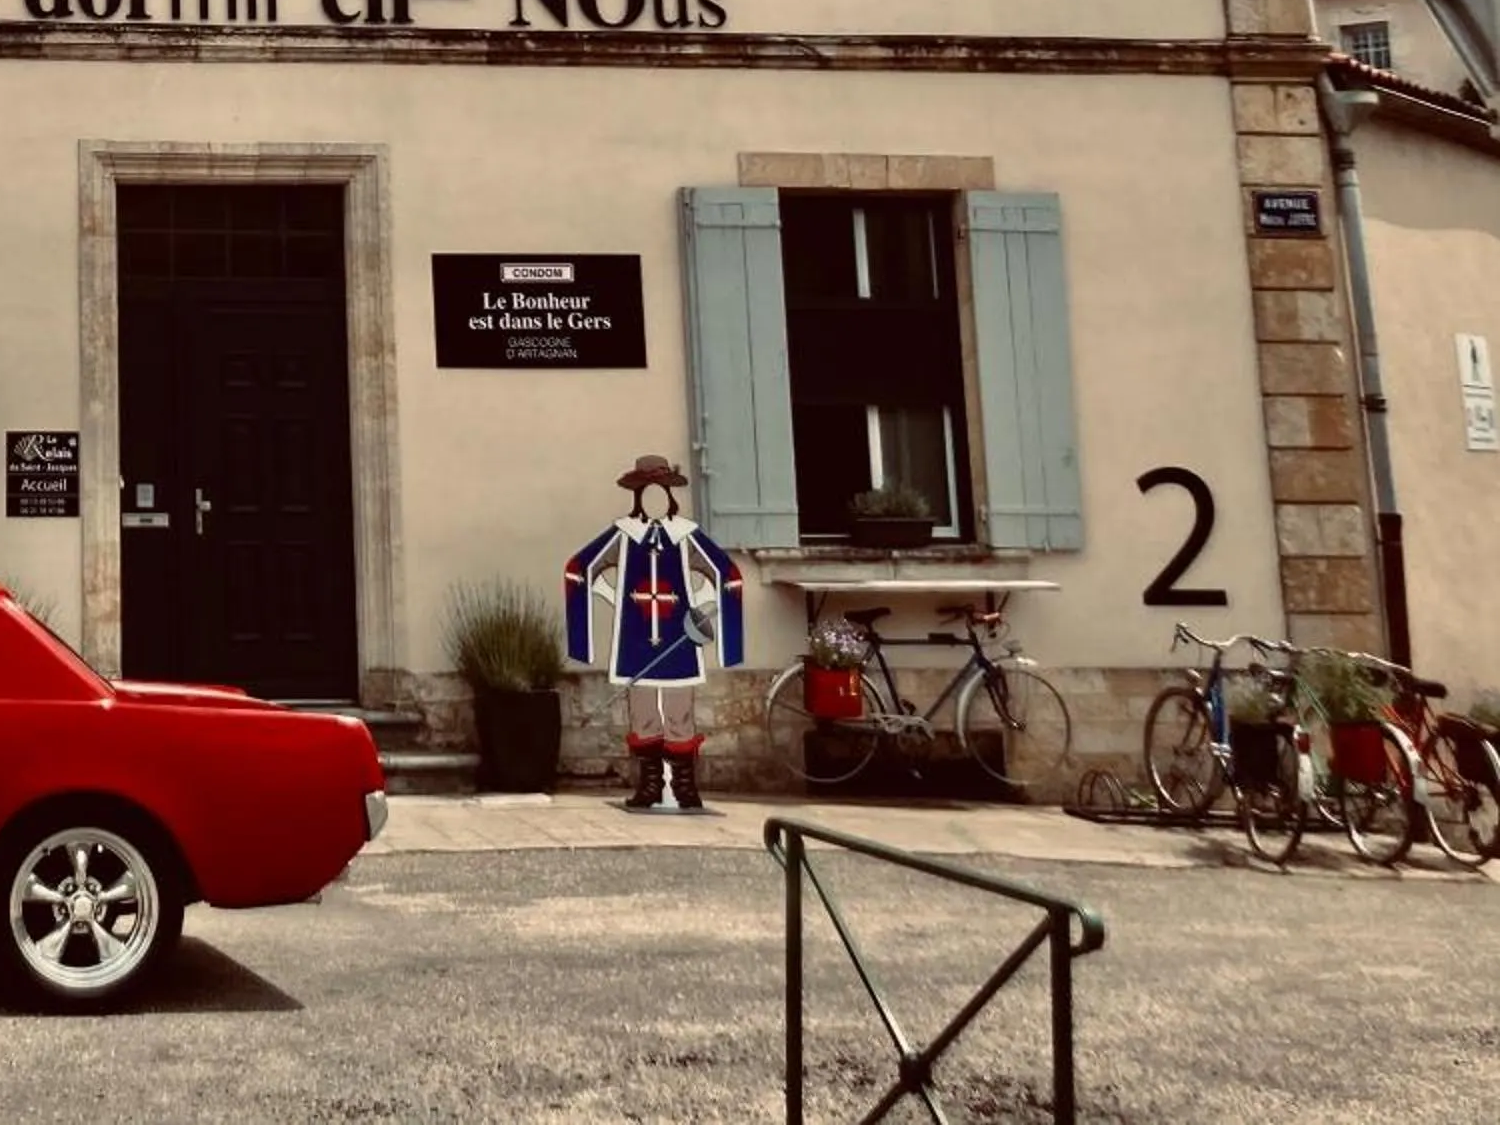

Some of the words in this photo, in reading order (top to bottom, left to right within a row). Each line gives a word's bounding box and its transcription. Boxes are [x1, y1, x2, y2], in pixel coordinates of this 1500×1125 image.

[512, 268, 563, 278] CONDOM
[483, 292, 507, 310] Le
[511, 292, 591, 310] Bonheur
[468, 314, 494, 330] est
[499, 312, 543, 330] dans
[547, 312, 563, 330] le
[567, 314, 612, 330] Gers
[508, 336, 571, 348] GASCOGNE
[21, 478, 67, 492] Accueil
[1136, 466, 1228, 606] 2
